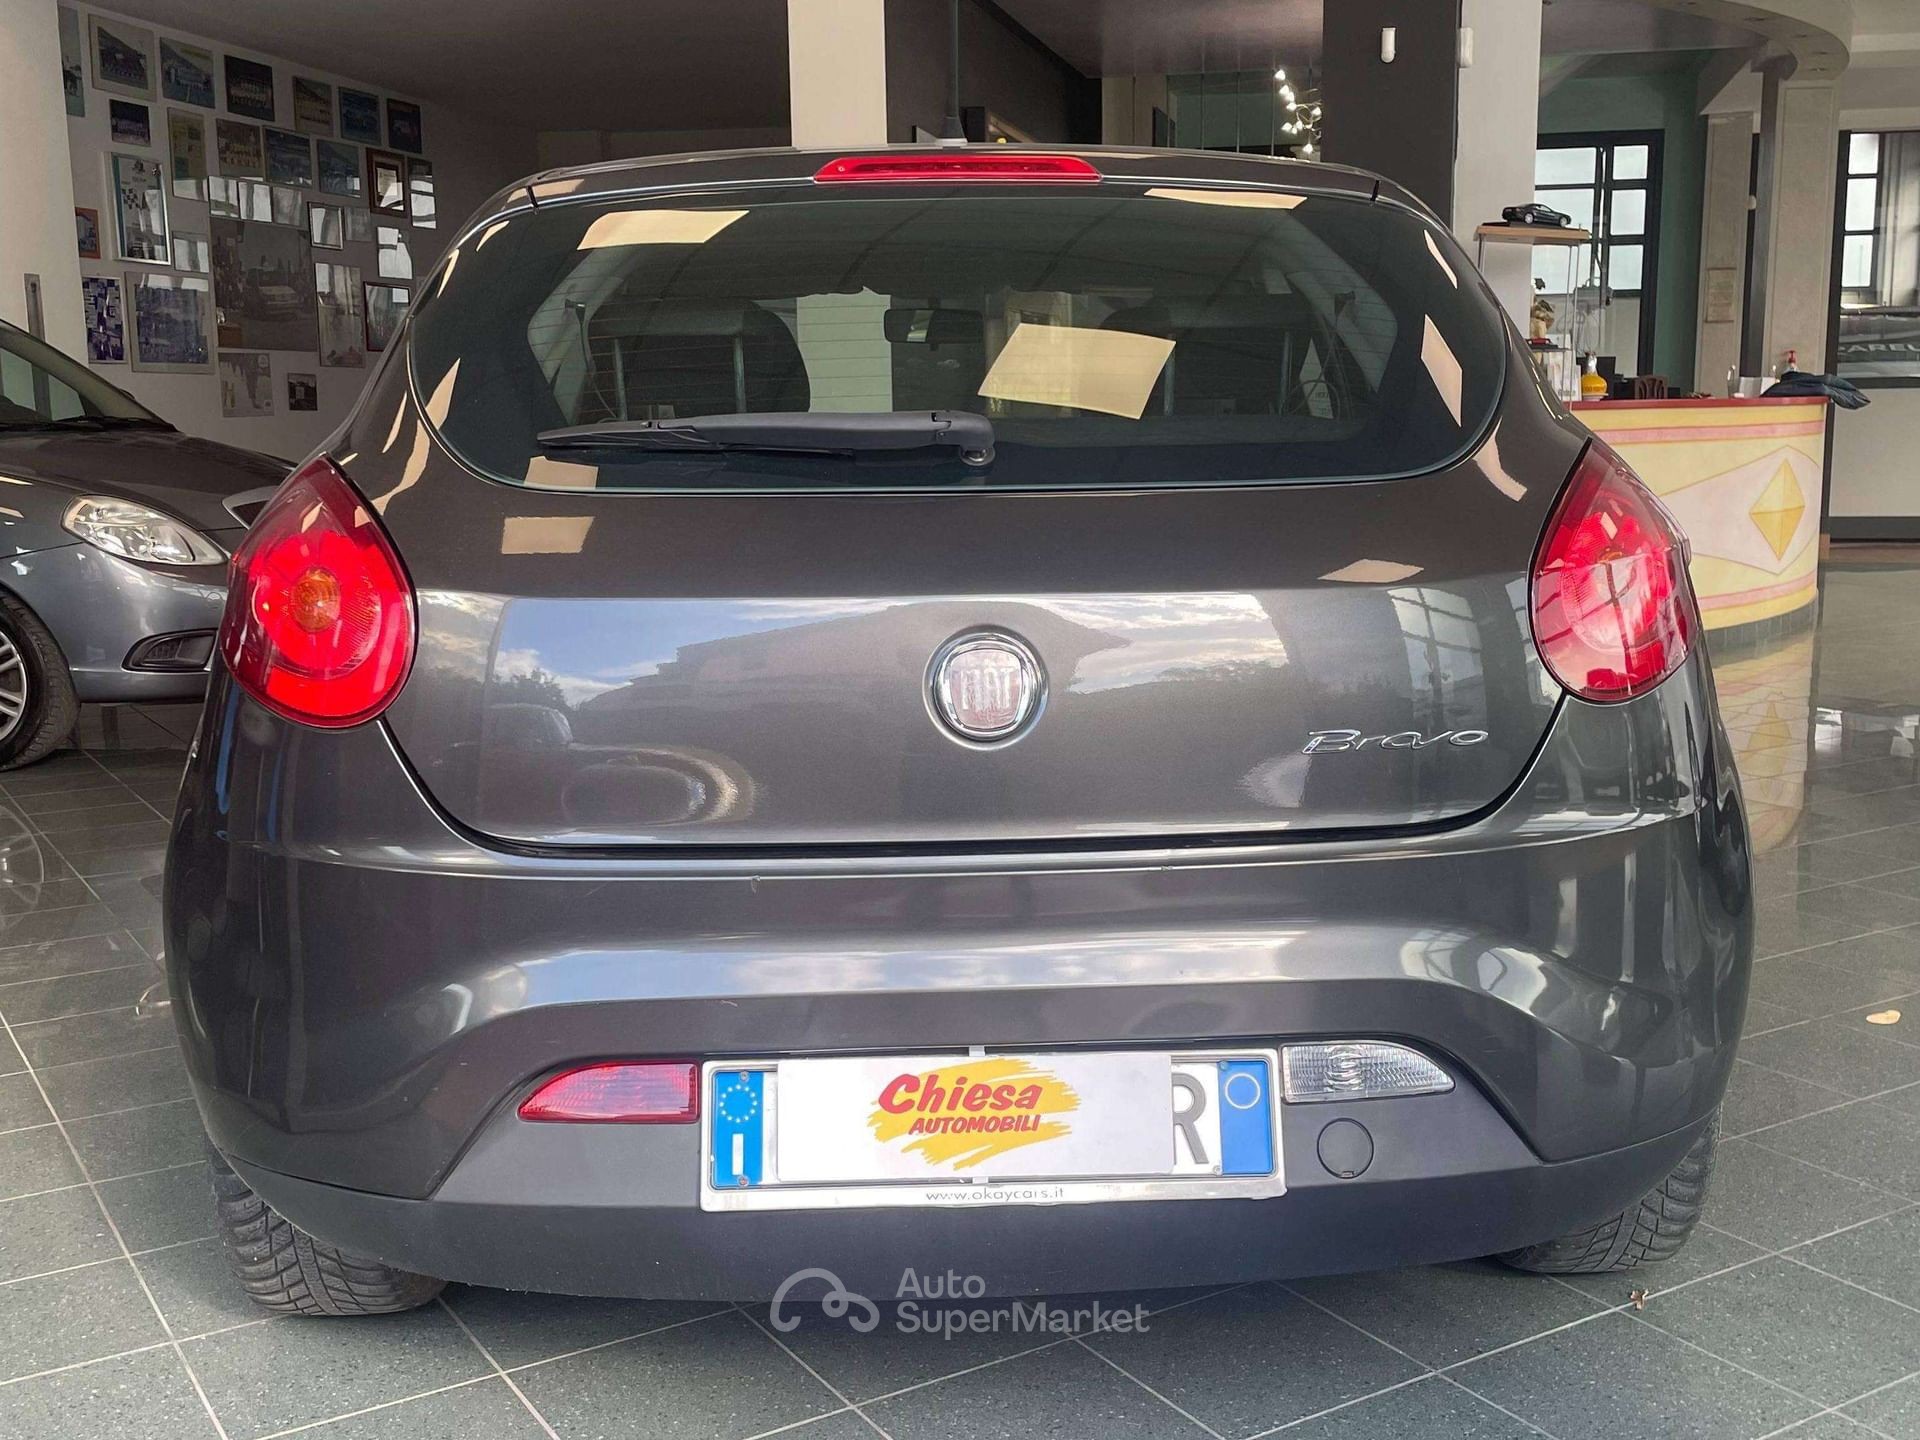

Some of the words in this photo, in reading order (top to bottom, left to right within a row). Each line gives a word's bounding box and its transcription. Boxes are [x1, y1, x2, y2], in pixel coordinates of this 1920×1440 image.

[1302, 729, 1489, 754] Bravo
[878, 1073, 1043, 1114] Chiesa
[908, 1114, 1042, 1136] AUTOMOBILI
[1171, 1072, 1210, 1166] R
[732, 1133, 744, 1175] I
[925, 1186, 1064, 1202] www.okaycars.it
